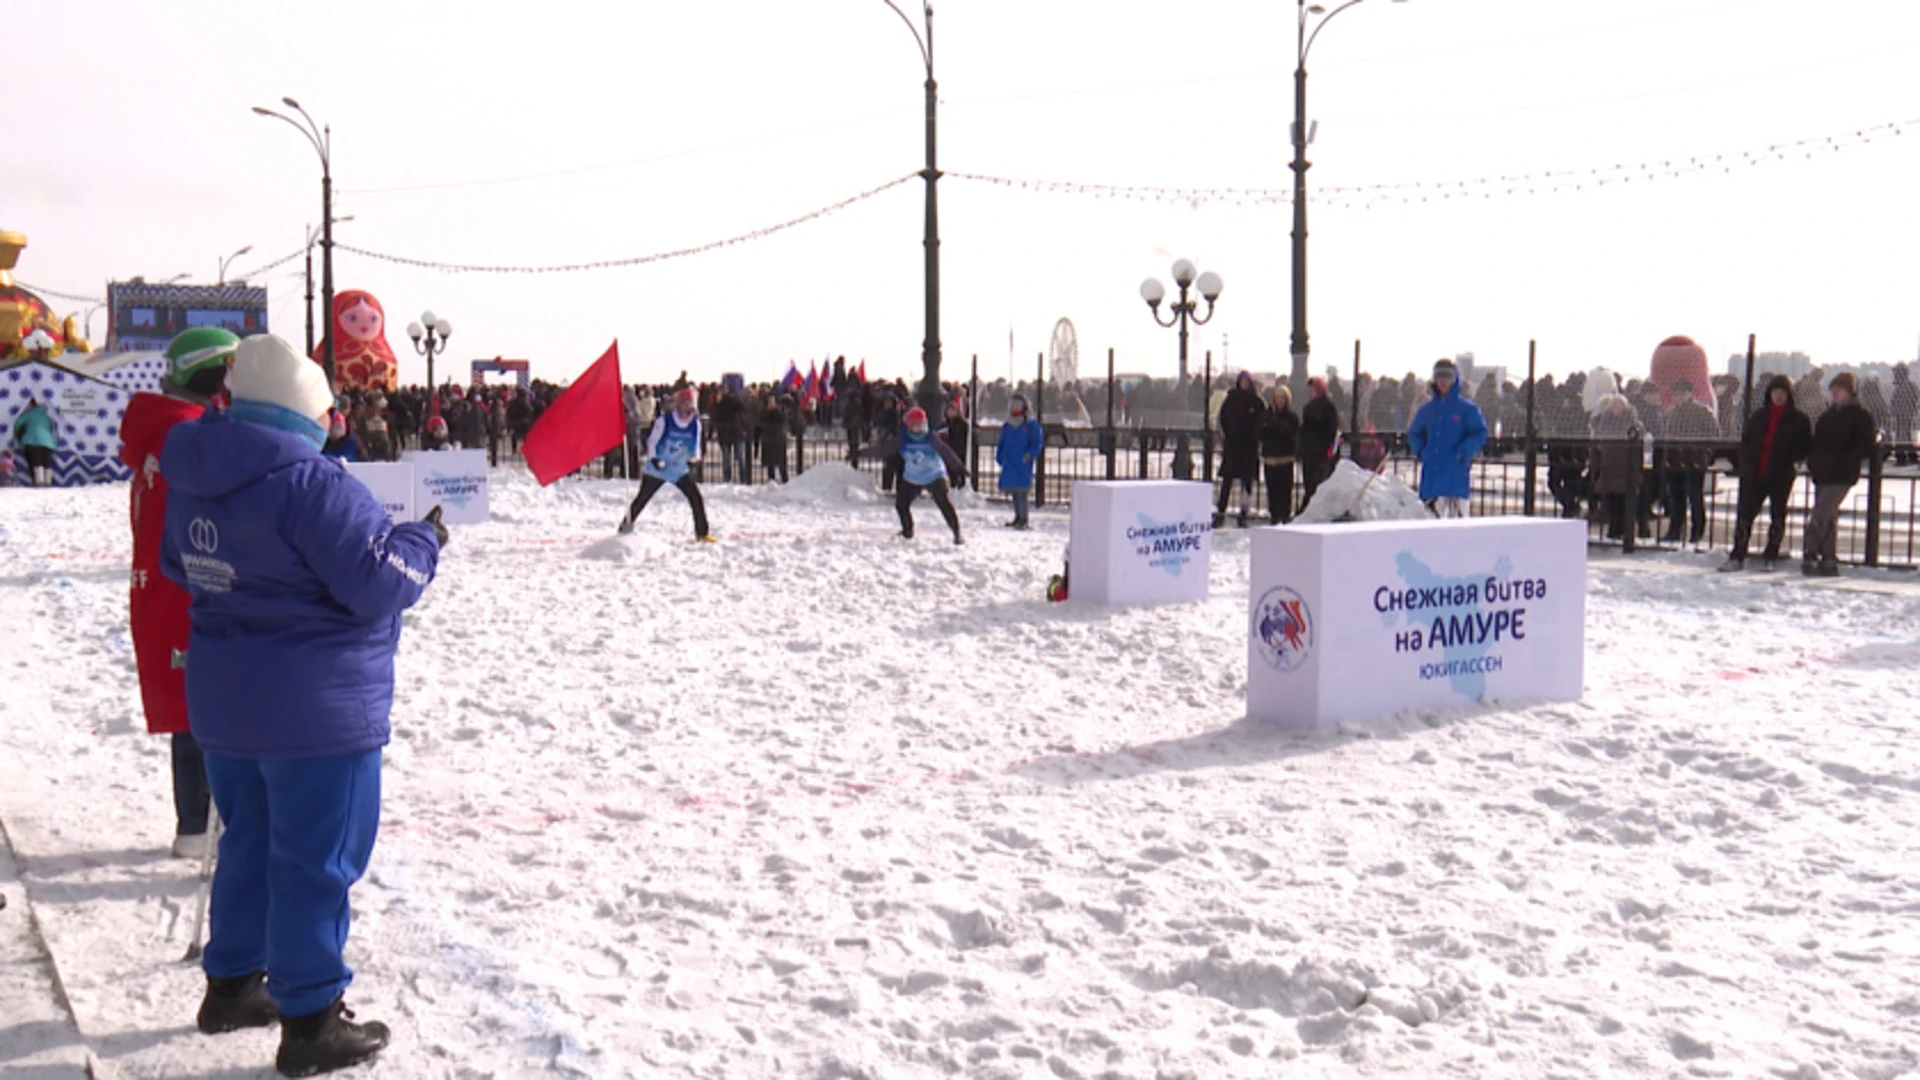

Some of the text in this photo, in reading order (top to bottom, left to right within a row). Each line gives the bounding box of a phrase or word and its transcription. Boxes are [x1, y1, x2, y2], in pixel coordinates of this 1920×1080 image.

[1126, 521, 1211, 540] Снежная битва
[1136, 535, 1201, 555] на АМУРЕ
[1373, 576, 1547, 612] Снежная битва
[1395, 608, 1526, 652] на АМУРЕ
[1419, 655, 1503, 680] ЮКИГАССЕН
